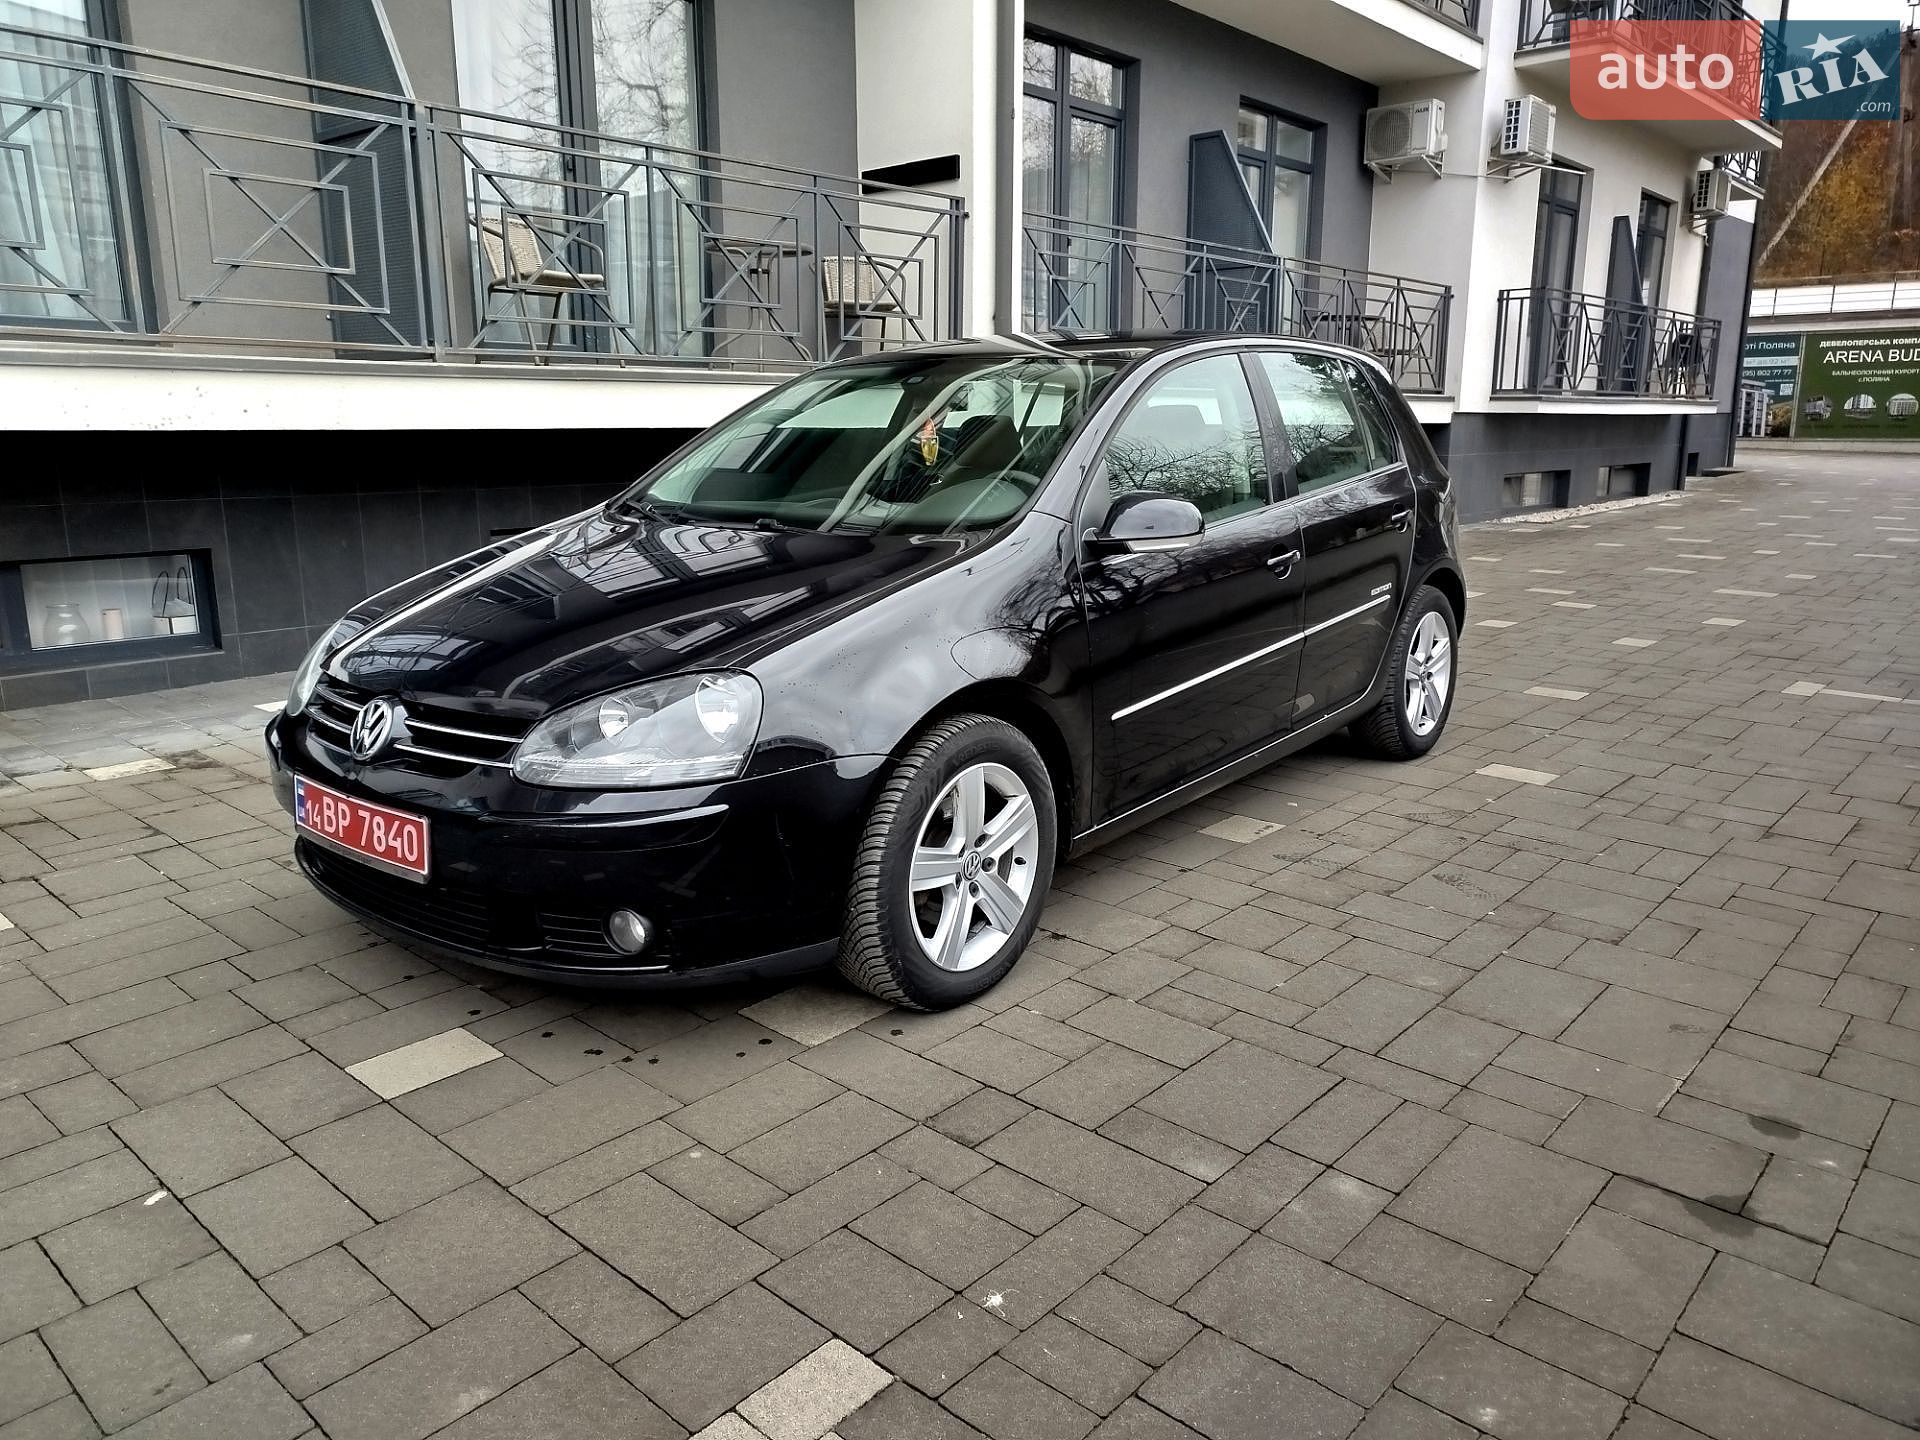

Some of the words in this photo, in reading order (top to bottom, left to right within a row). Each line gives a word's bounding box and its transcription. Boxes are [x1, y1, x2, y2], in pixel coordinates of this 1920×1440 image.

[1759, 341, 1796, 350] Поляна
[1819, 338, 1891, 348] ДЕВЕЛОПЕРСЬКА
[1823, 349, 1885, 364] ARENA
[357, 809, 418, 862] 7840
